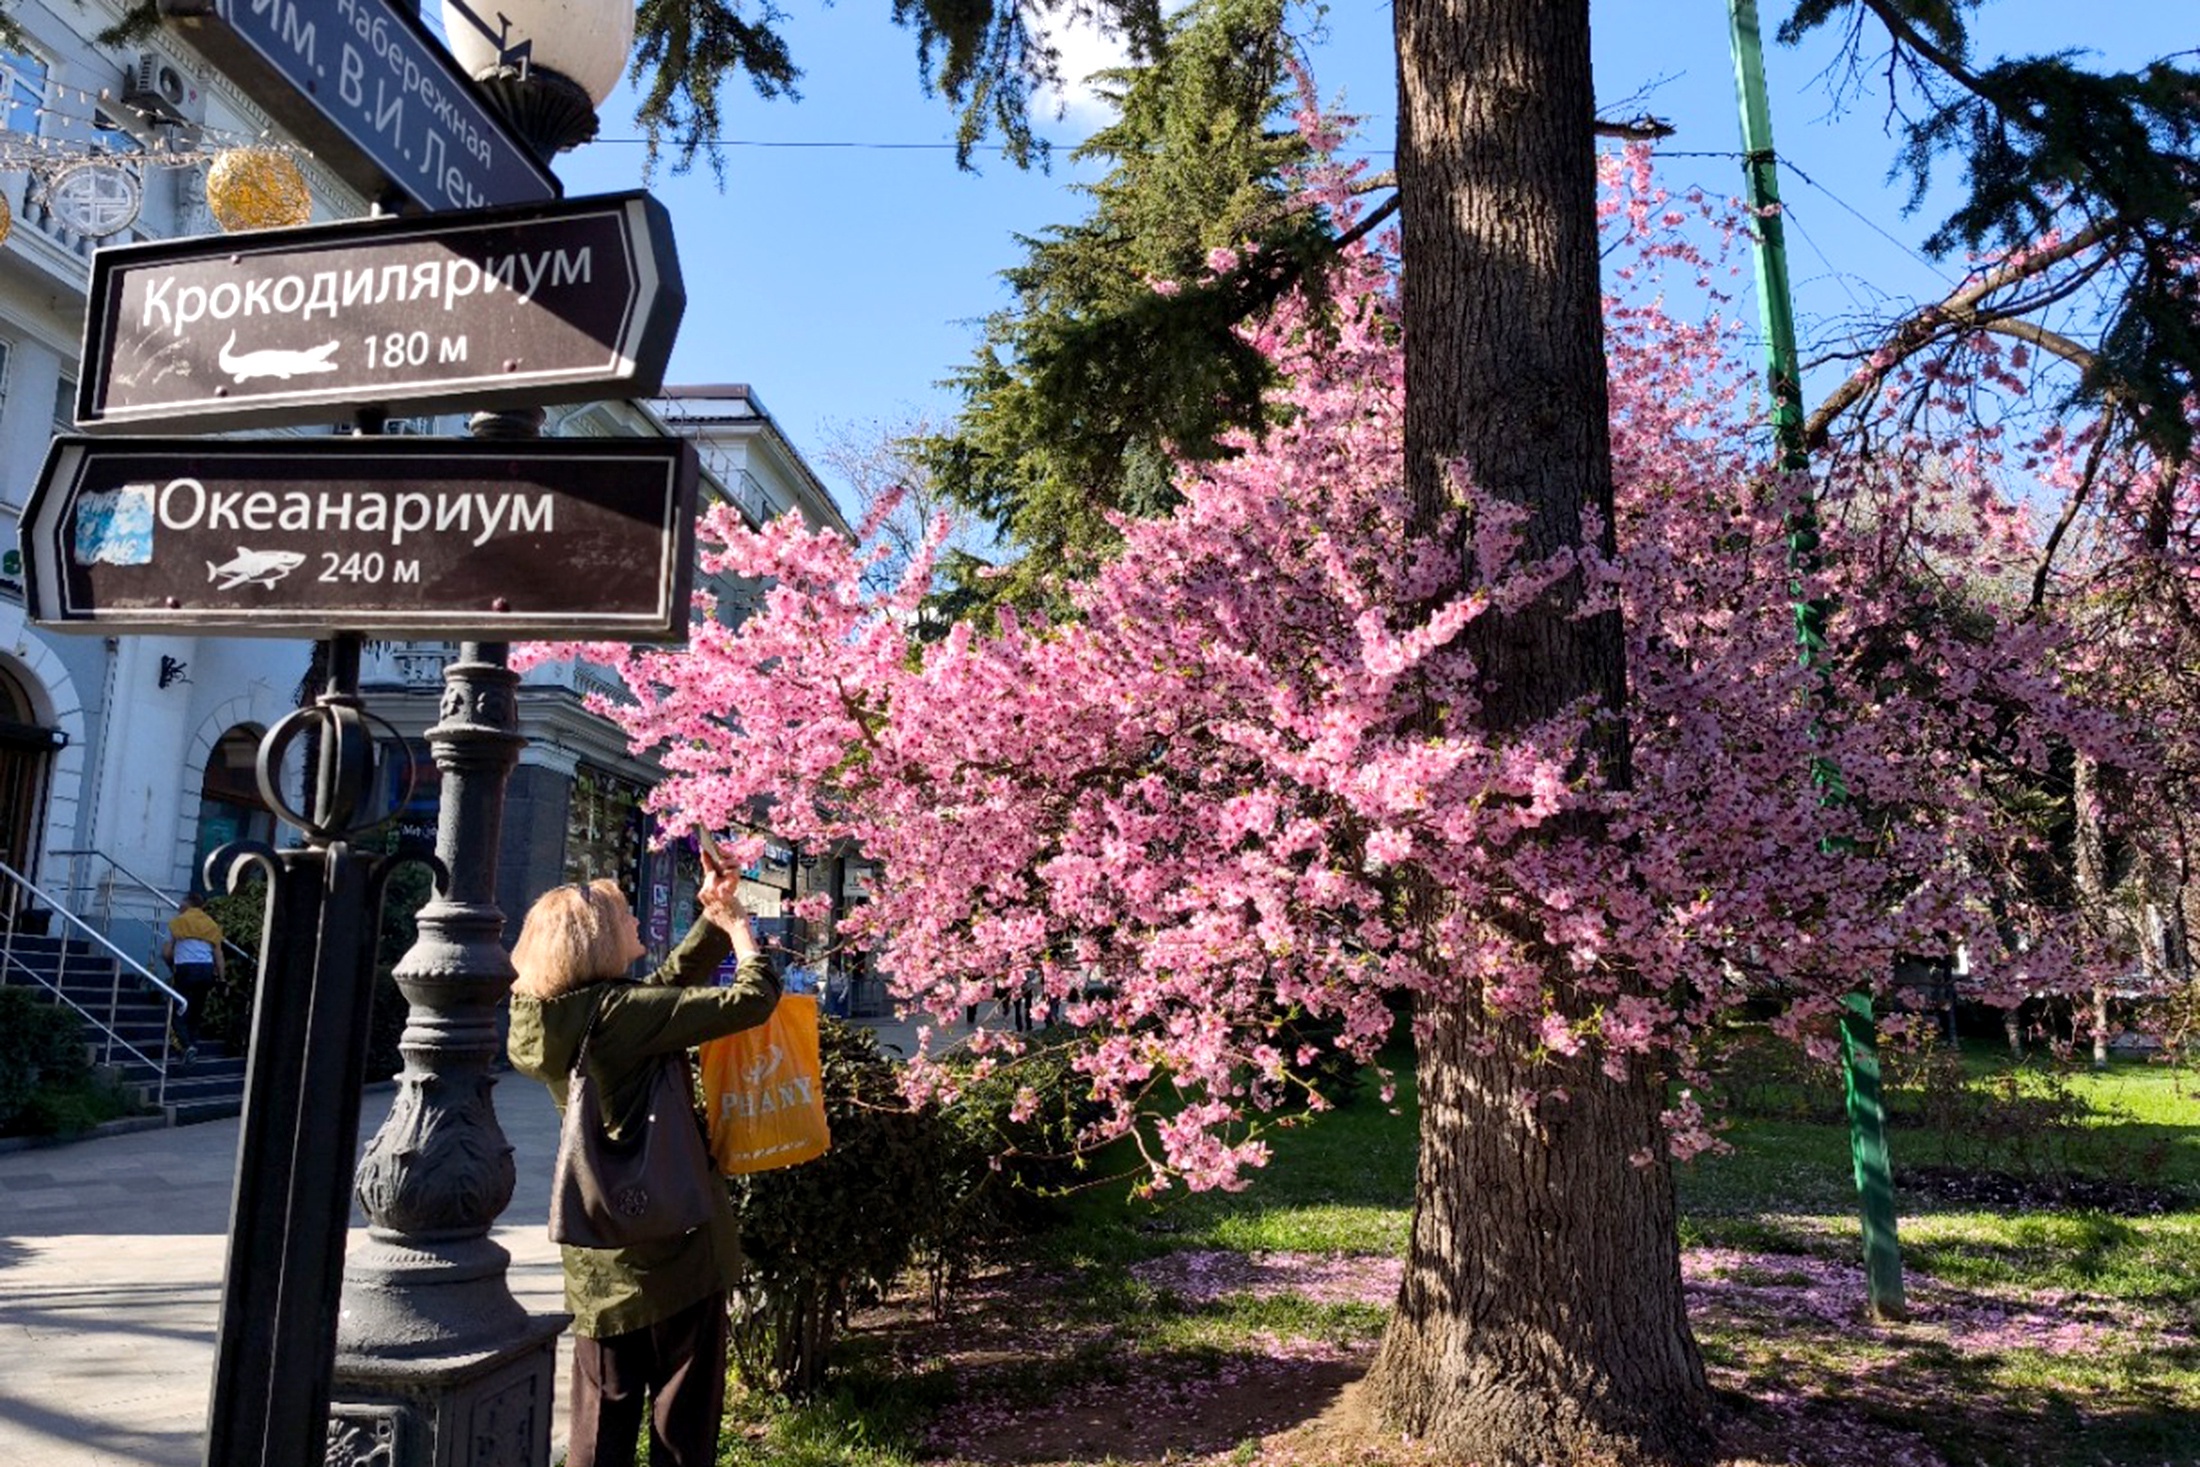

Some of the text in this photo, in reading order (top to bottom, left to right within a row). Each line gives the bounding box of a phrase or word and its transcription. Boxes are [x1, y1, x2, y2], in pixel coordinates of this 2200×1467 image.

[338, 42, 411, 161] В.И.
[418, 127, 493, 209] Лен
[142, 245, 592, 337] Крокодиляриум
[363, 330, 468, 370] 180 м
[158, 477, 555, 547] Океанариум
[317, 552, 421, 584] 240 м
